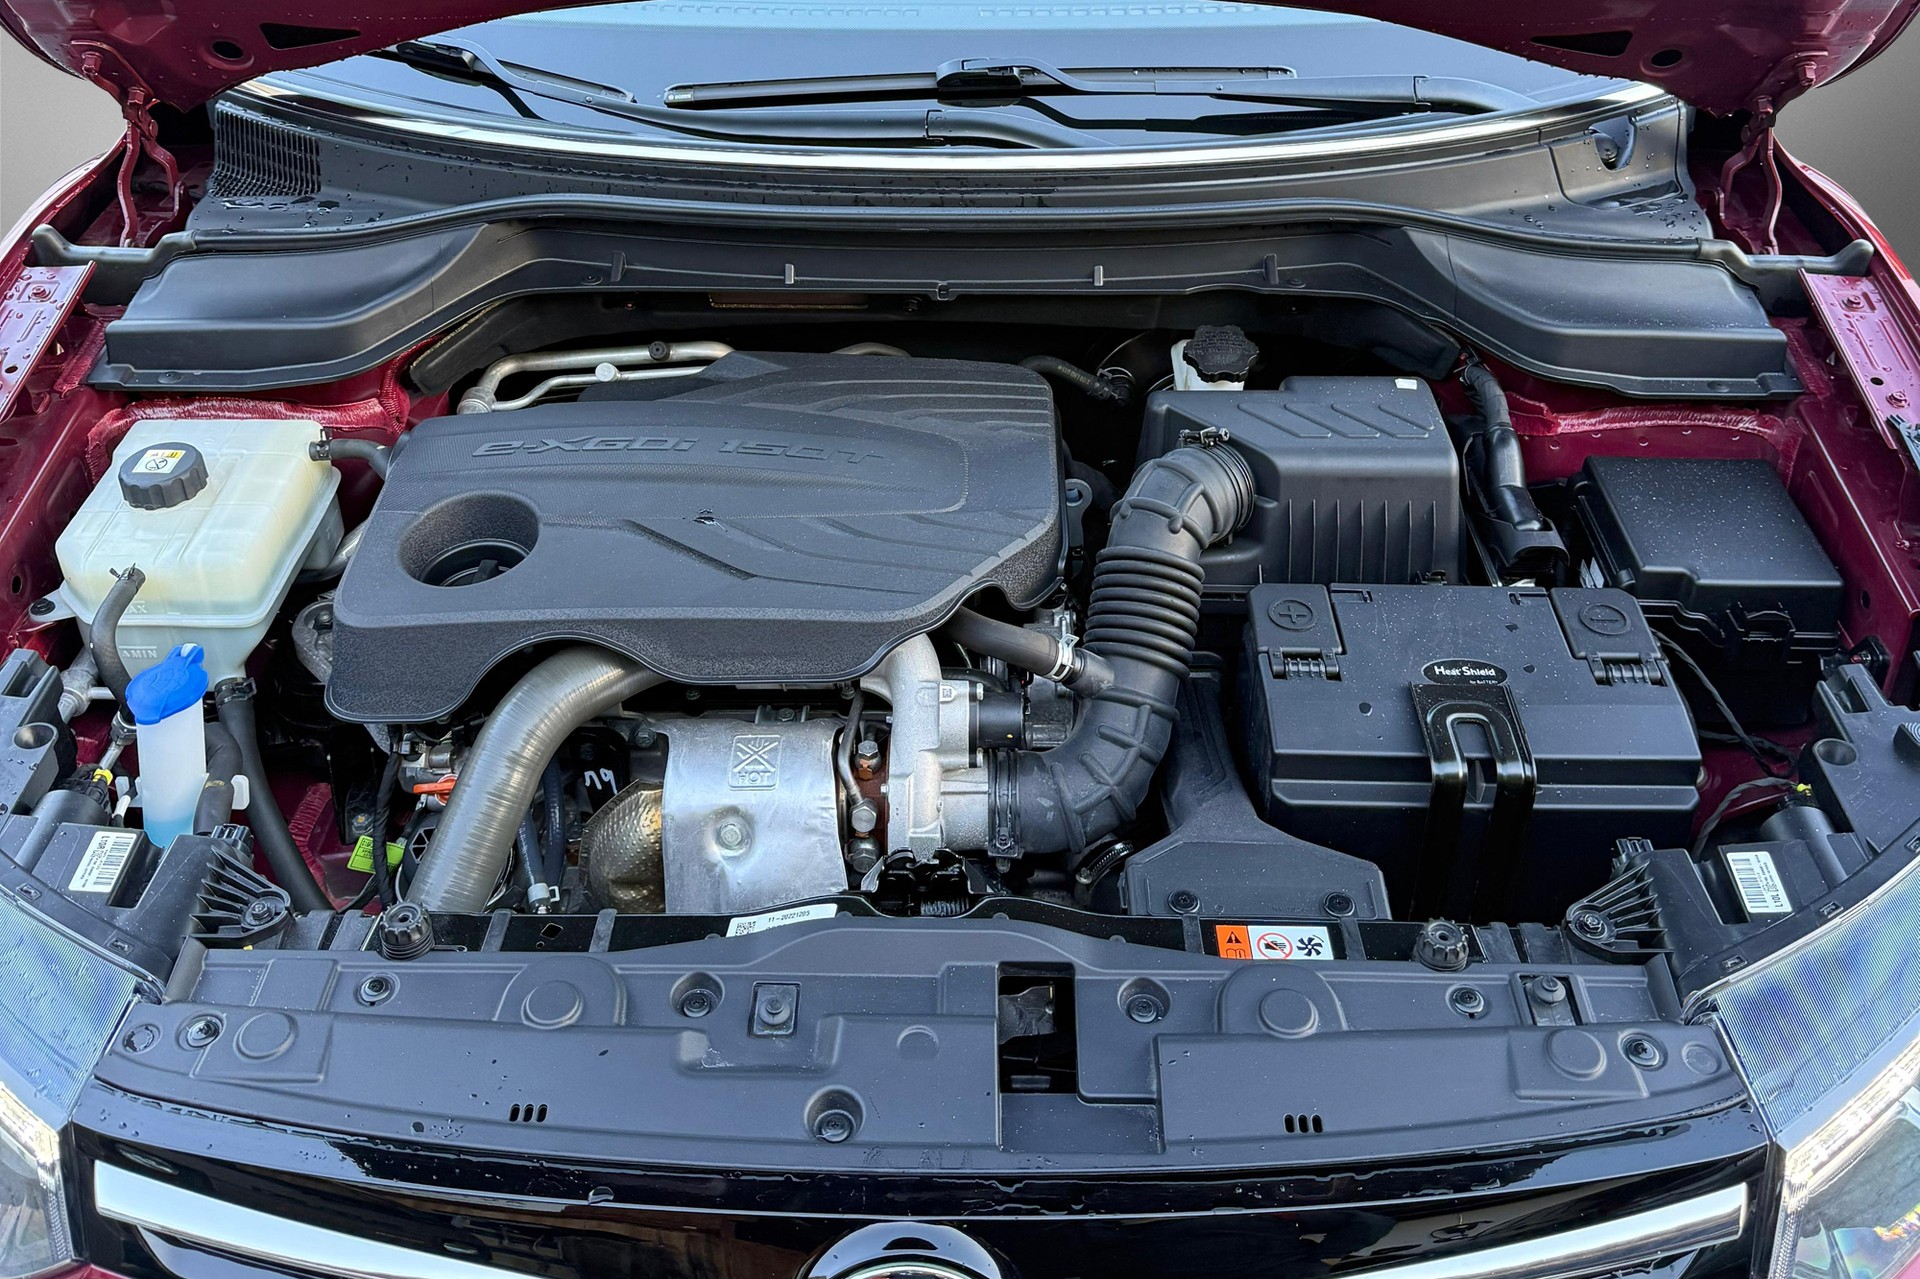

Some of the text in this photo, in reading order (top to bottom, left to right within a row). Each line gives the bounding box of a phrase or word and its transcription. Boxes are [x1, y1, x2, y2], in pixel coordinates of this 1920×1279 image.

[718, 439, 885, 464] 150T
[125, 604, 147, 613] AX
[1433, 665, 1496, 676] Heat Shield
[737, 770, 772, 785] HOT
